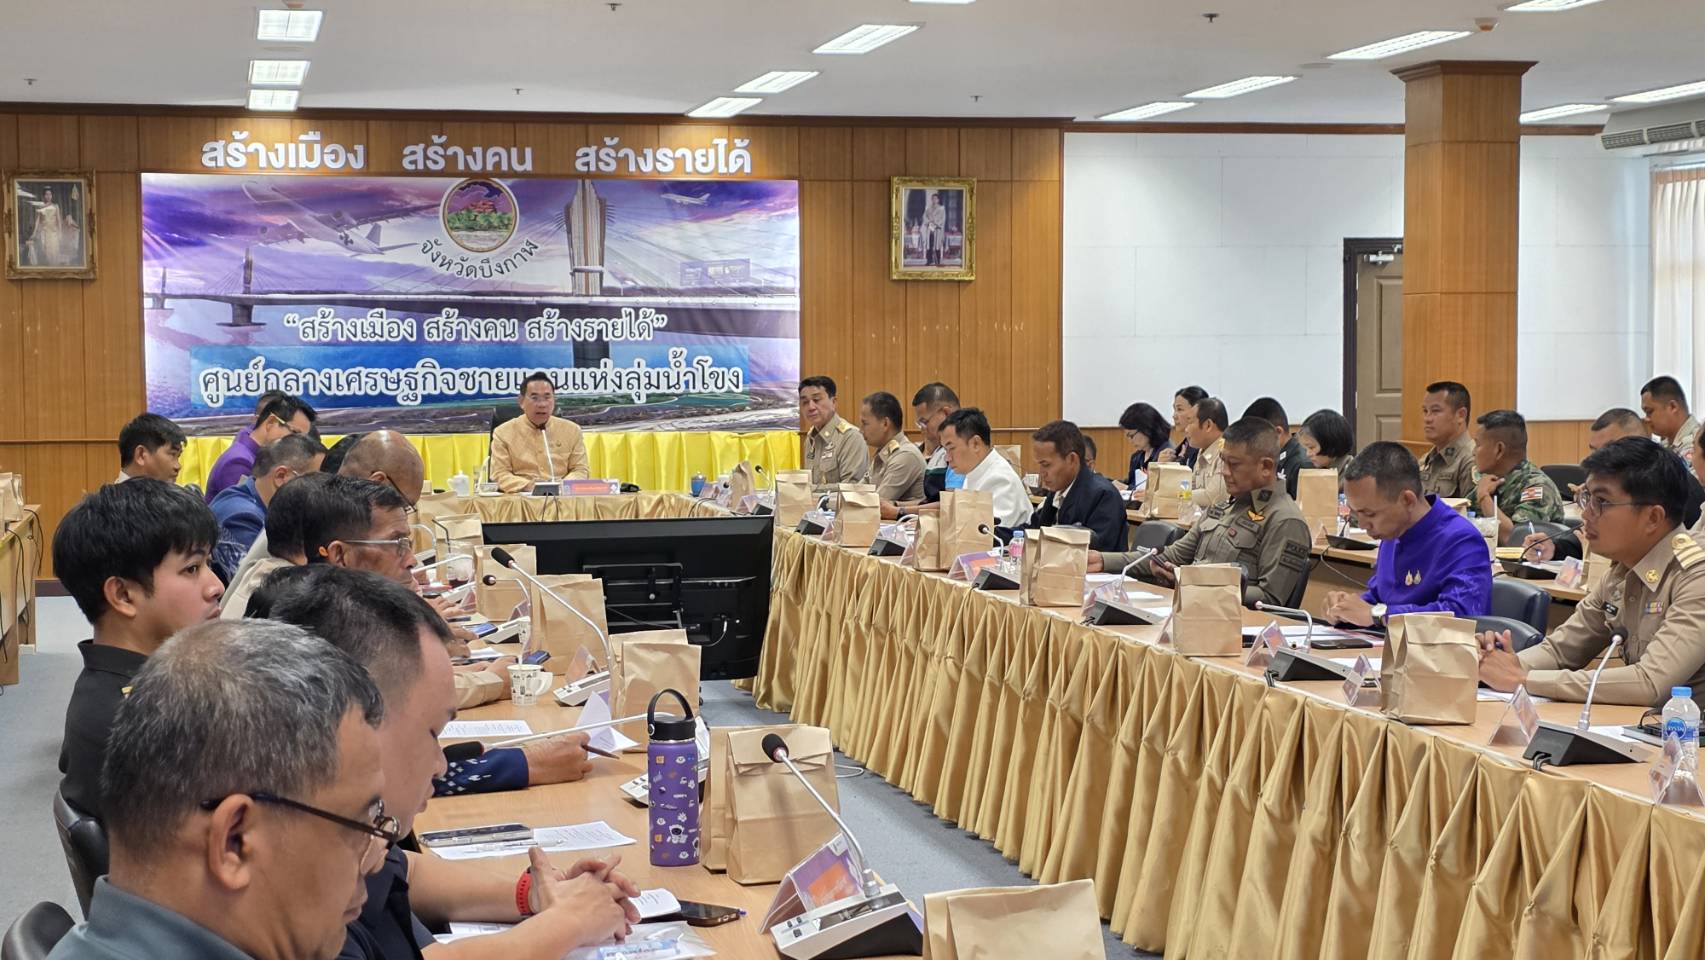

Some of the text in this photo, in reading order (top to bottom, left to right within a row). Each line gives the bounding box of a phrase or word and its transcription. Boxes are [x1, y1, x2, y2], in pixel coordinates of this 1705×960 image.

[201, 130, 751, 174] สร้างเมือง สร้างคน สร้างรายได้
[421, 238, 539, 279] จังหวัดบึงกาฬ
[425, 309, 517, 340] สร้างคน
[202, 350, 742, 403] ศูนย์กลางเศรษฐกิจชายแนแห่งลุ่มน้ำโขง
